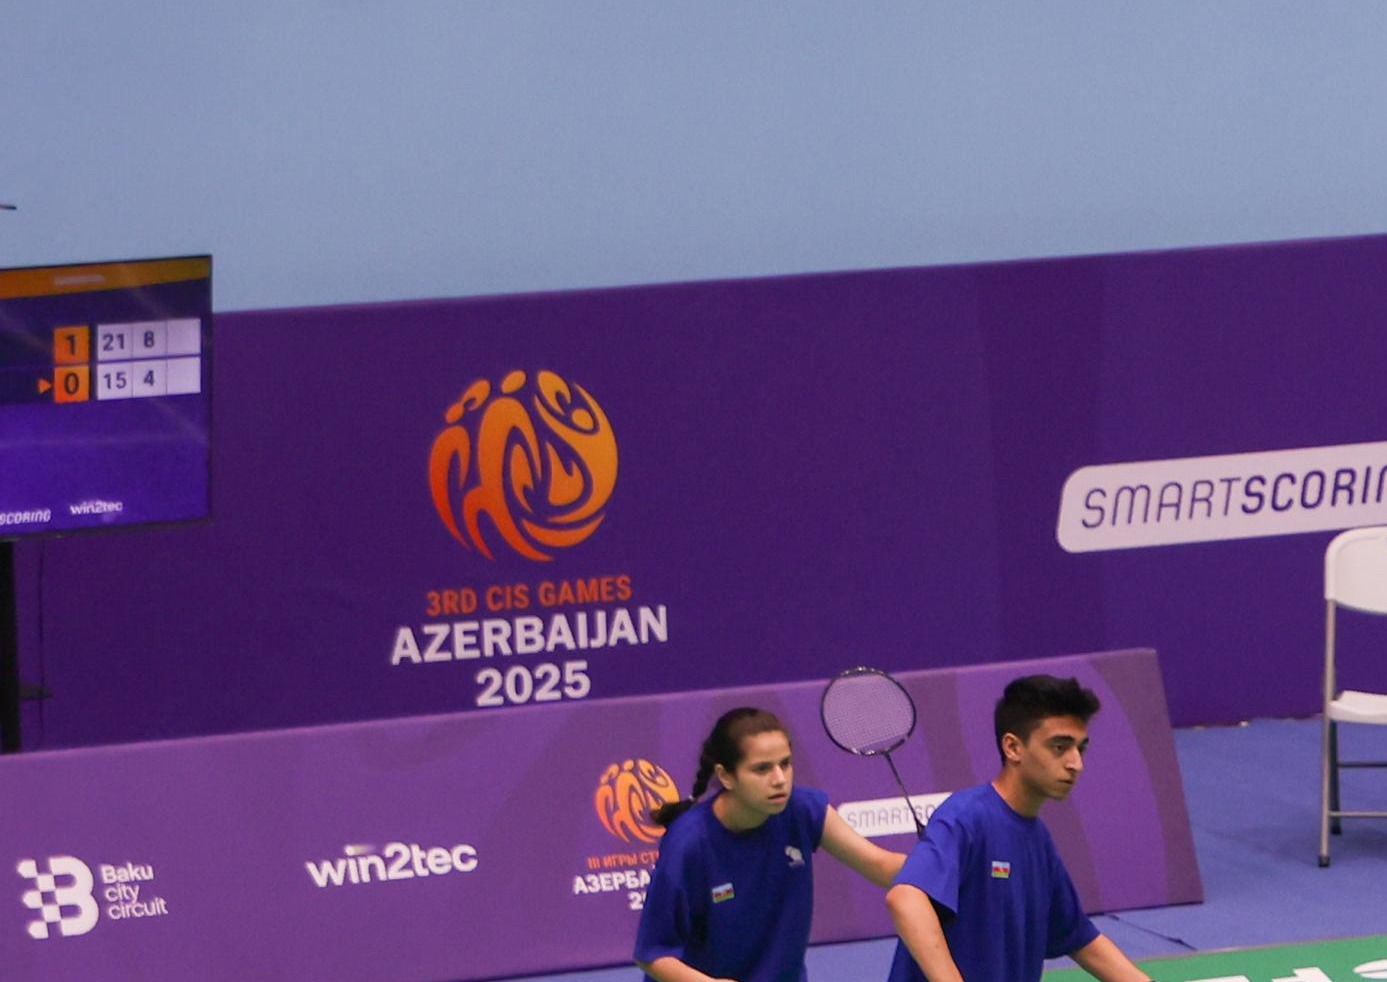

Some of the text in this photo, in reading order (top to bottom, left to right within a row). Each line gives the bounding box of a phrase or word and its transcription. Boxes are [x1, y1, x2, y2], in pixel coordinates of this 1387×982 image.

[66, 334, 76, 355] 1
[103, 330, 155, 351] 21 8
[64, 373, 79, 394] 0
[104, 370, 155, 389] 15 4
[69, 500, 123, 516] win2tec
[425, 574, 633, 617] 3RD CIS GAMES
[390, 604, 669, 666] AZERBAIJAN
[475, 659, 593, 708] 2025
[100, 862, 154, 884] Baku
[305, 841, 479, 889] win2tec
[104, 883, 140, 903] city
[107, 895, 169, 921] circuit
